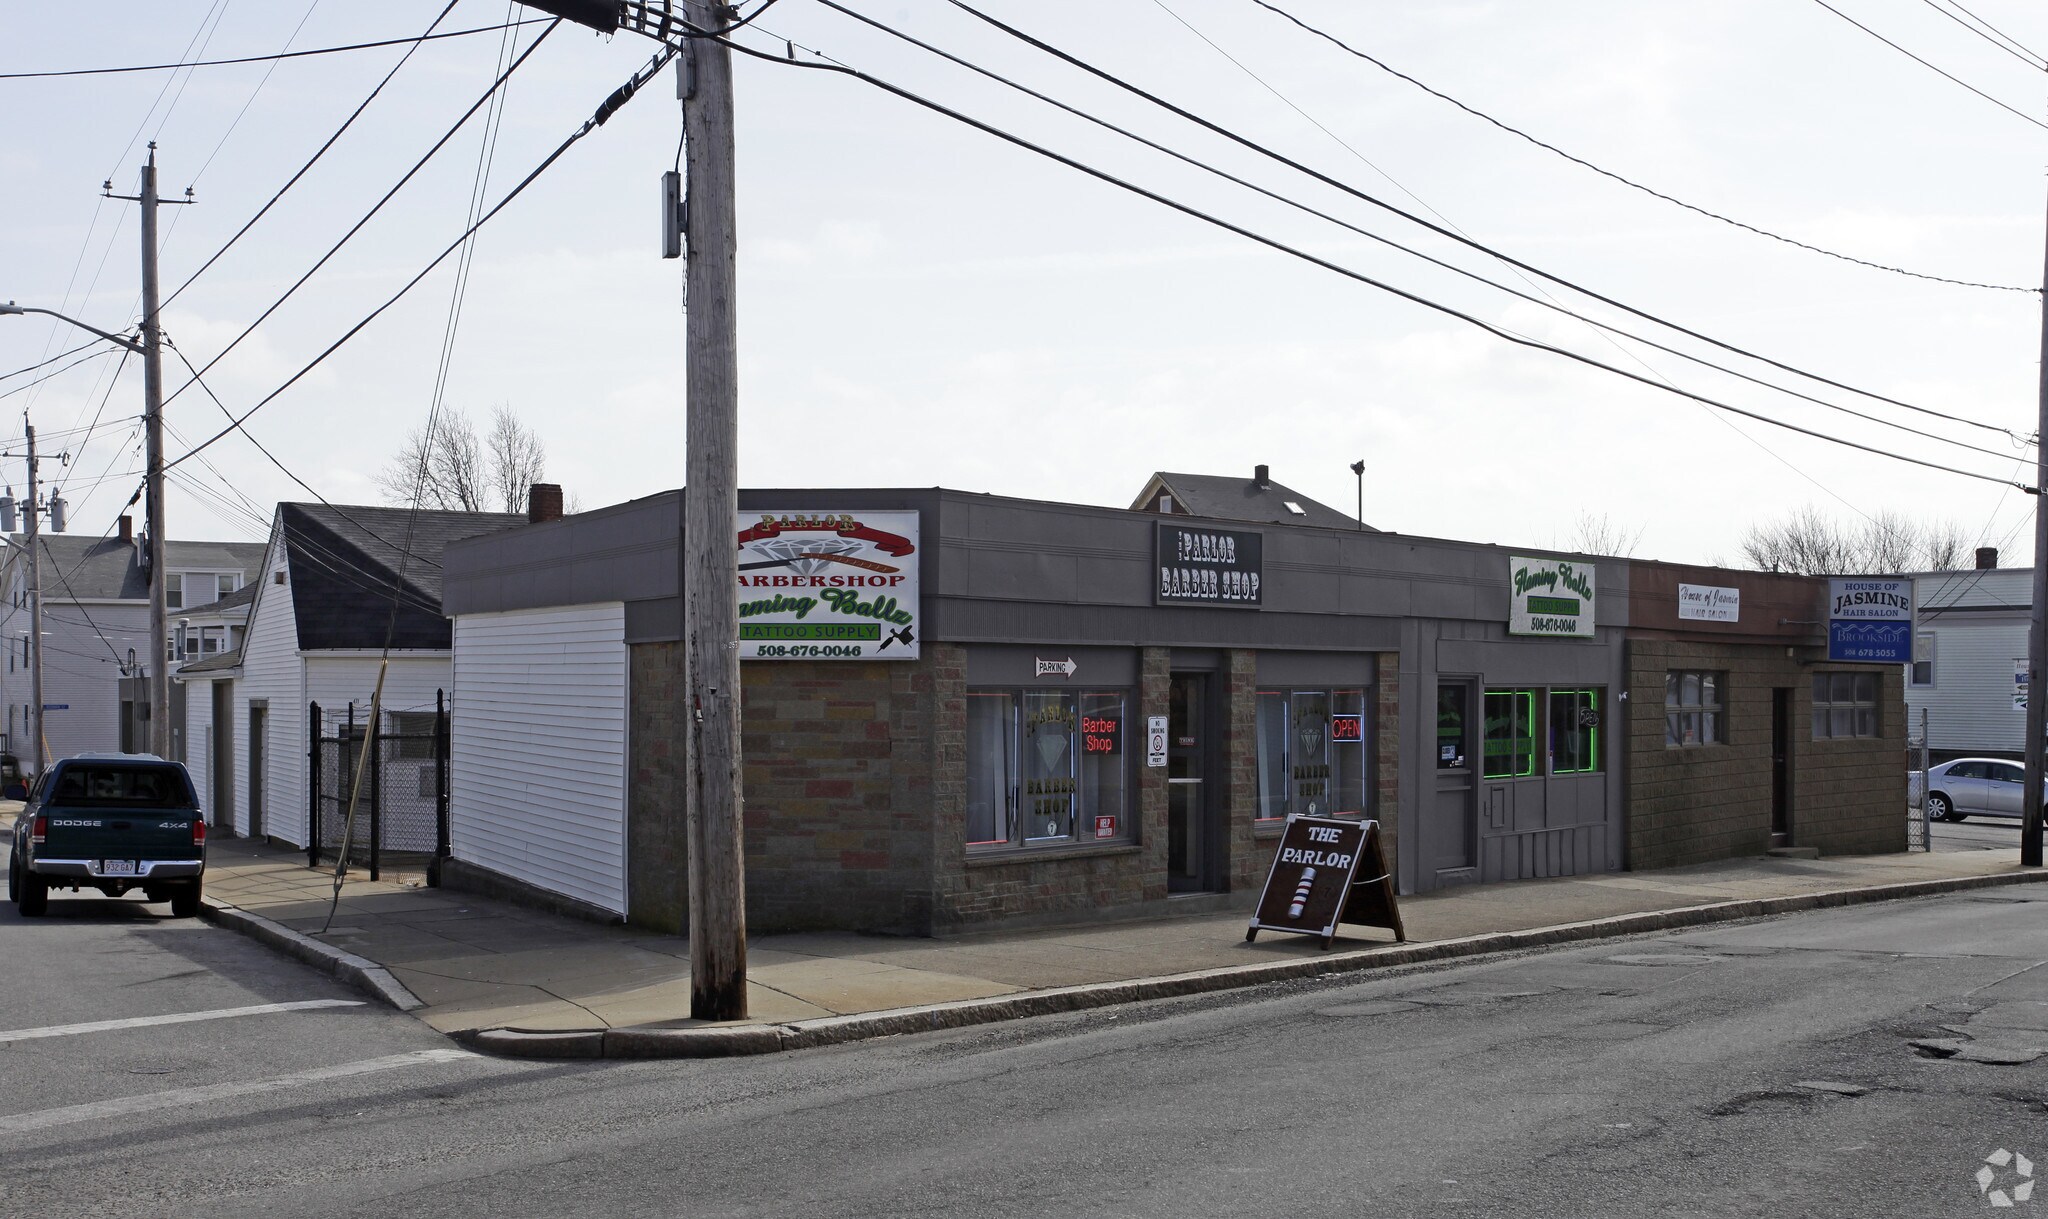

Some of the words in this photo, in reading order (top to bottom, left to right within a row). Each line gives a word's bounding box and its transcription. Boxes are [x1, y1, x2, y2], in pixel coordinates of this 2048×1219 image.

[761, 514, 856, 532] PARLOR
[1183, 533, 1236, 564] PARLOR
[738, 575, 906, 587] ARBERSHOP
[1161, 567, 1219, 599] BARBER
[1222, 571, 1260, 601] SHOP
[1515, 566, 1558, 597] Flaming
[739, 593, 818, 619] aming
[820, 587, 913, 625] Ballz
[1834, 592, 1909, 615] JASMINE
[744, 627, 807, 637] TATTOO
[815, 627, 876, 637] SUPPLY
[757, 645, 862, 657] 508-676-0046
[1039, 662, 1066, 673] PARKING
[1083, 717, 1116, 733] Barber
[1333, 719, 1360, 738] OPEN
[1087, 735, 1113, 755] Shop
[1308, 826, 1343, 844] THE
[1281, 847, 1351, 869] PARLOR
